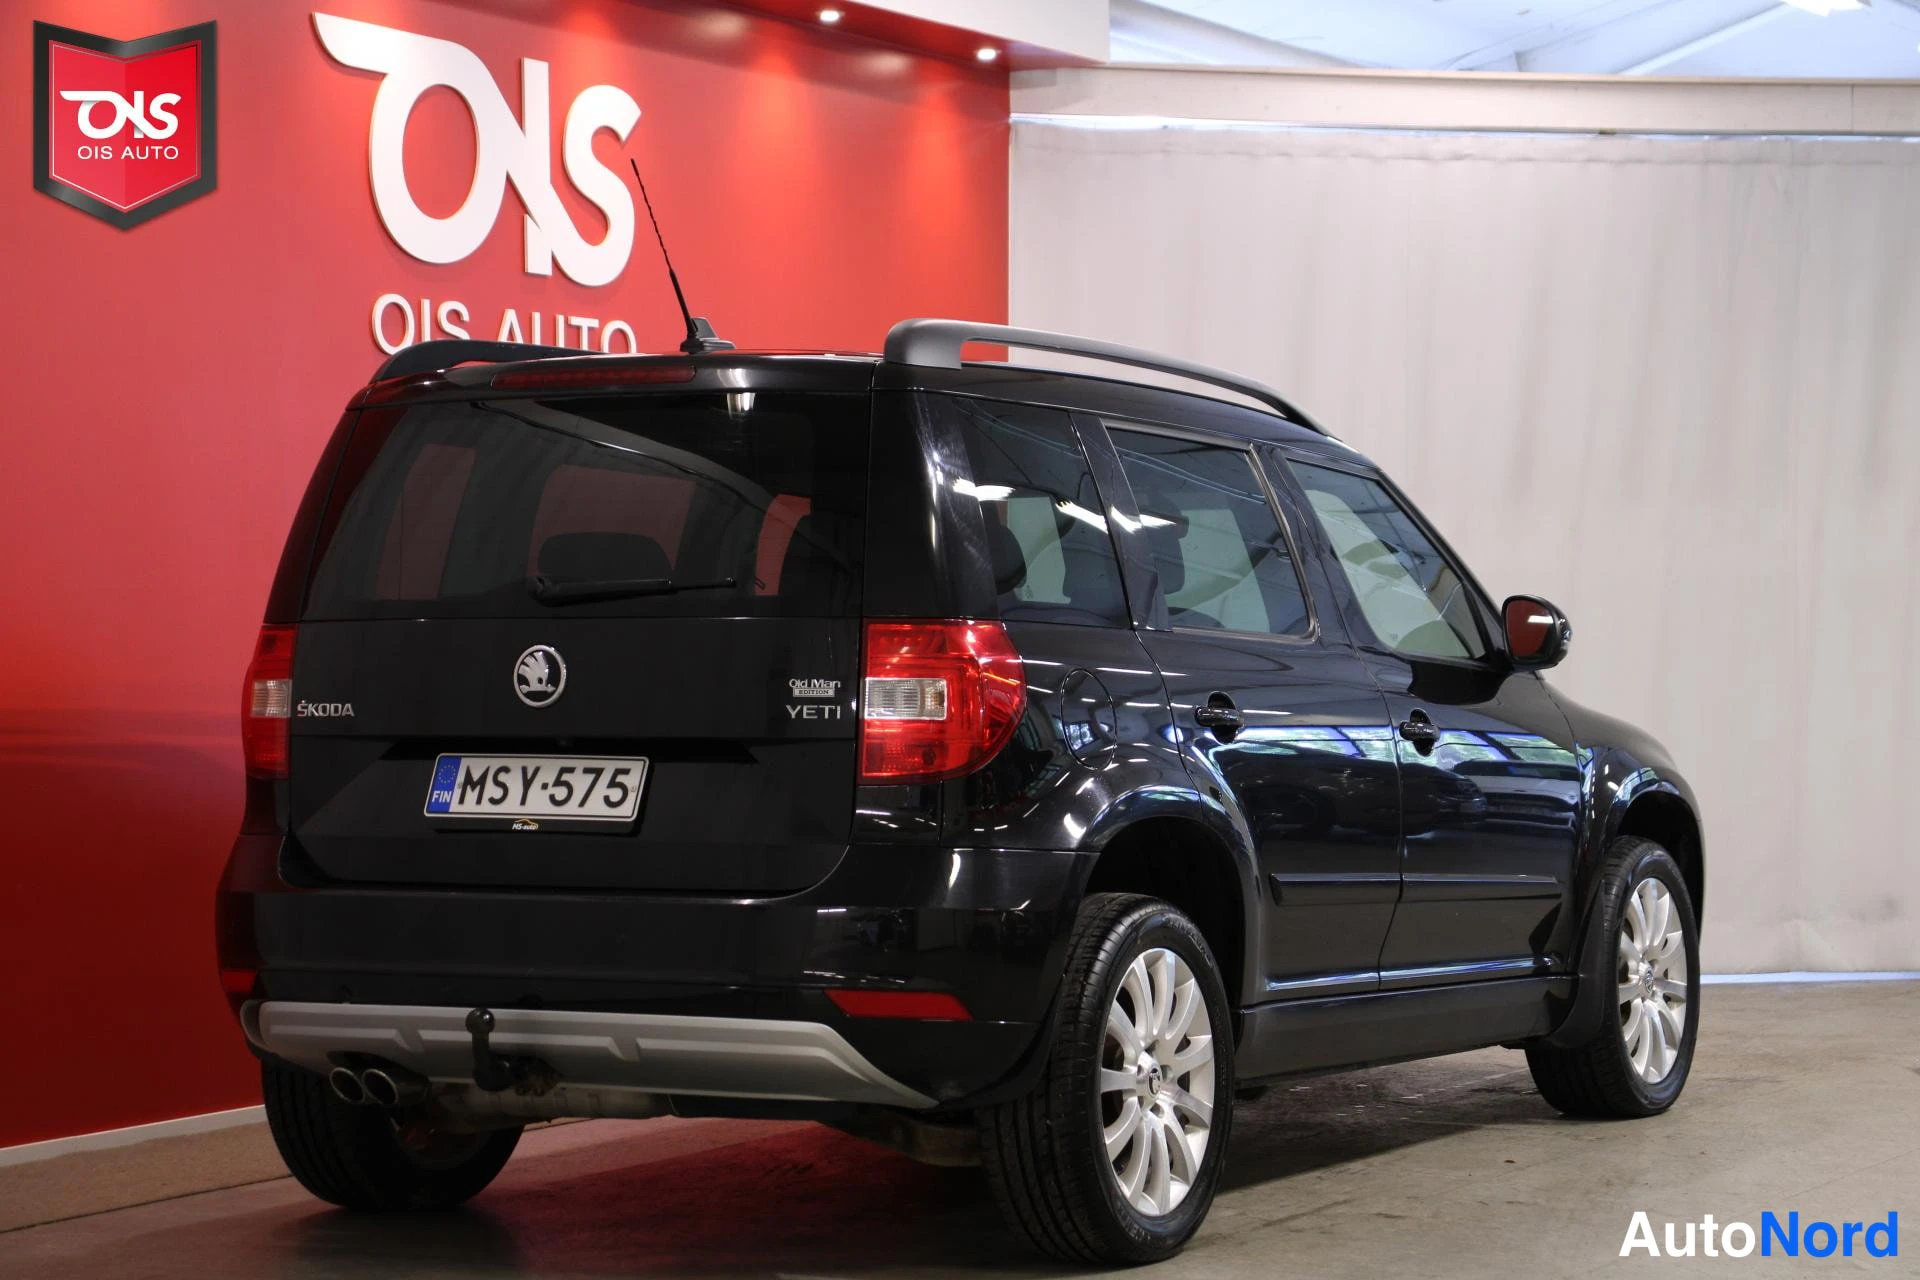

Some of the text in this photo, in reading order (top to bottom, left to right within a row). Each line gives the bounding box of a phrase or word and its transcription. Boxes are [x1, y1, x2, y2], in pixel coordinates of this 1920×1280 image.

[371, 293, 638, 356] OIS AUTO
[789, 678, 841, 688] Old Man
[785, 705, 841, 719] YETI
[458, 764, 632, 809] MSY-575
[431, 790, 454, 803] FIN
